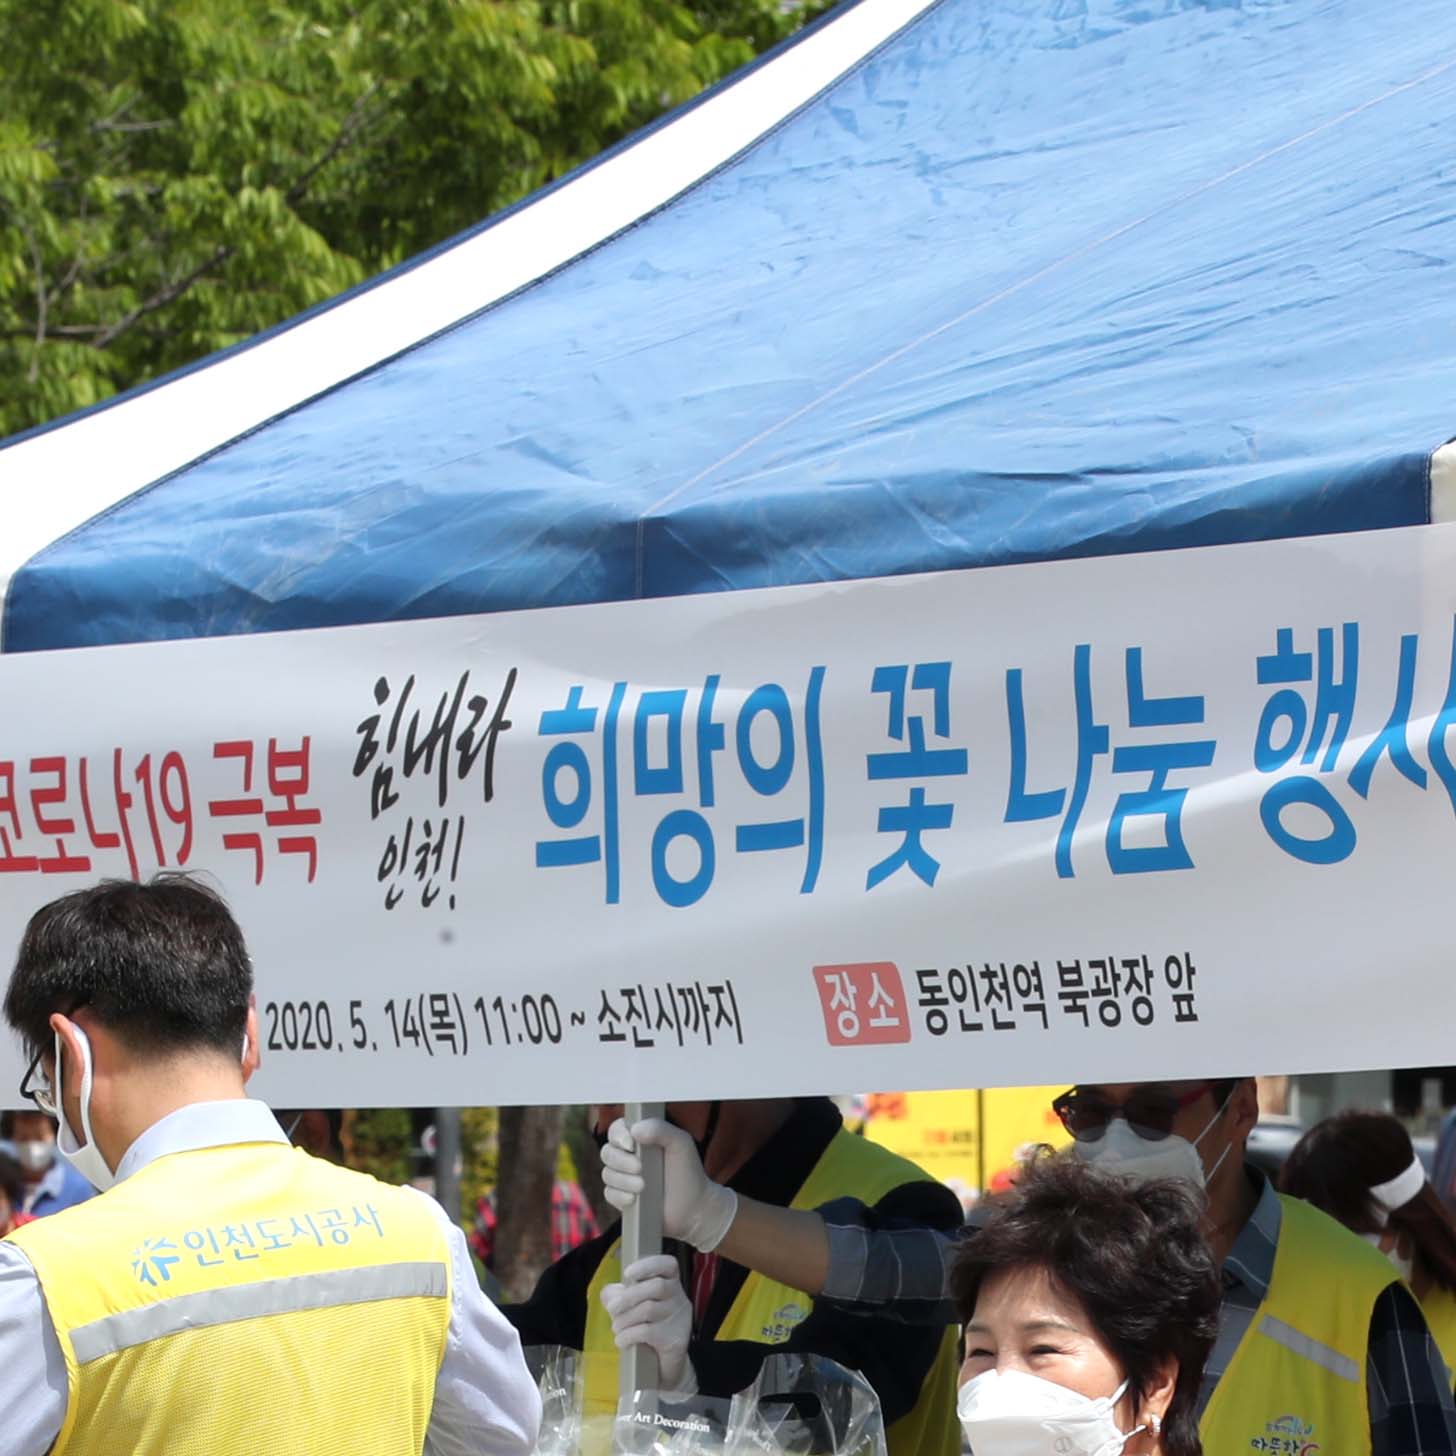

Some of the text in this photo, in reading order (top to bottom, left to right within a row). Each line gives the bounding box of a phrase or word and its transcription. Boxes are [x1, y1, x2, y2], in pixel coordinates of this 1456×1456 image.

[353, 666, 518, 820] 힘내라
[536, 665, 826, 908] 희망의
[866, 661, 968, 891] 꽃
[1004, 644, 1216, 878] 나눔
[208, 735, 322, 886] 극복
[377, 815, 465, 910] 인천!
[265, 1001, 343, 1052] 2020.
[349, 1000, 378, 1051] 5.
[474, 993, 562, 1046] 11:00
[597, 979, 743, 1049] 소진시까지
[823, 968, 901, 1039] 장소
[915, 952, 1199, 1036] 동인천역 북광장 앞
[182, 1202, 385, 1267] 인천도시공사
[653, 1413, 711, 1433] Decoration
